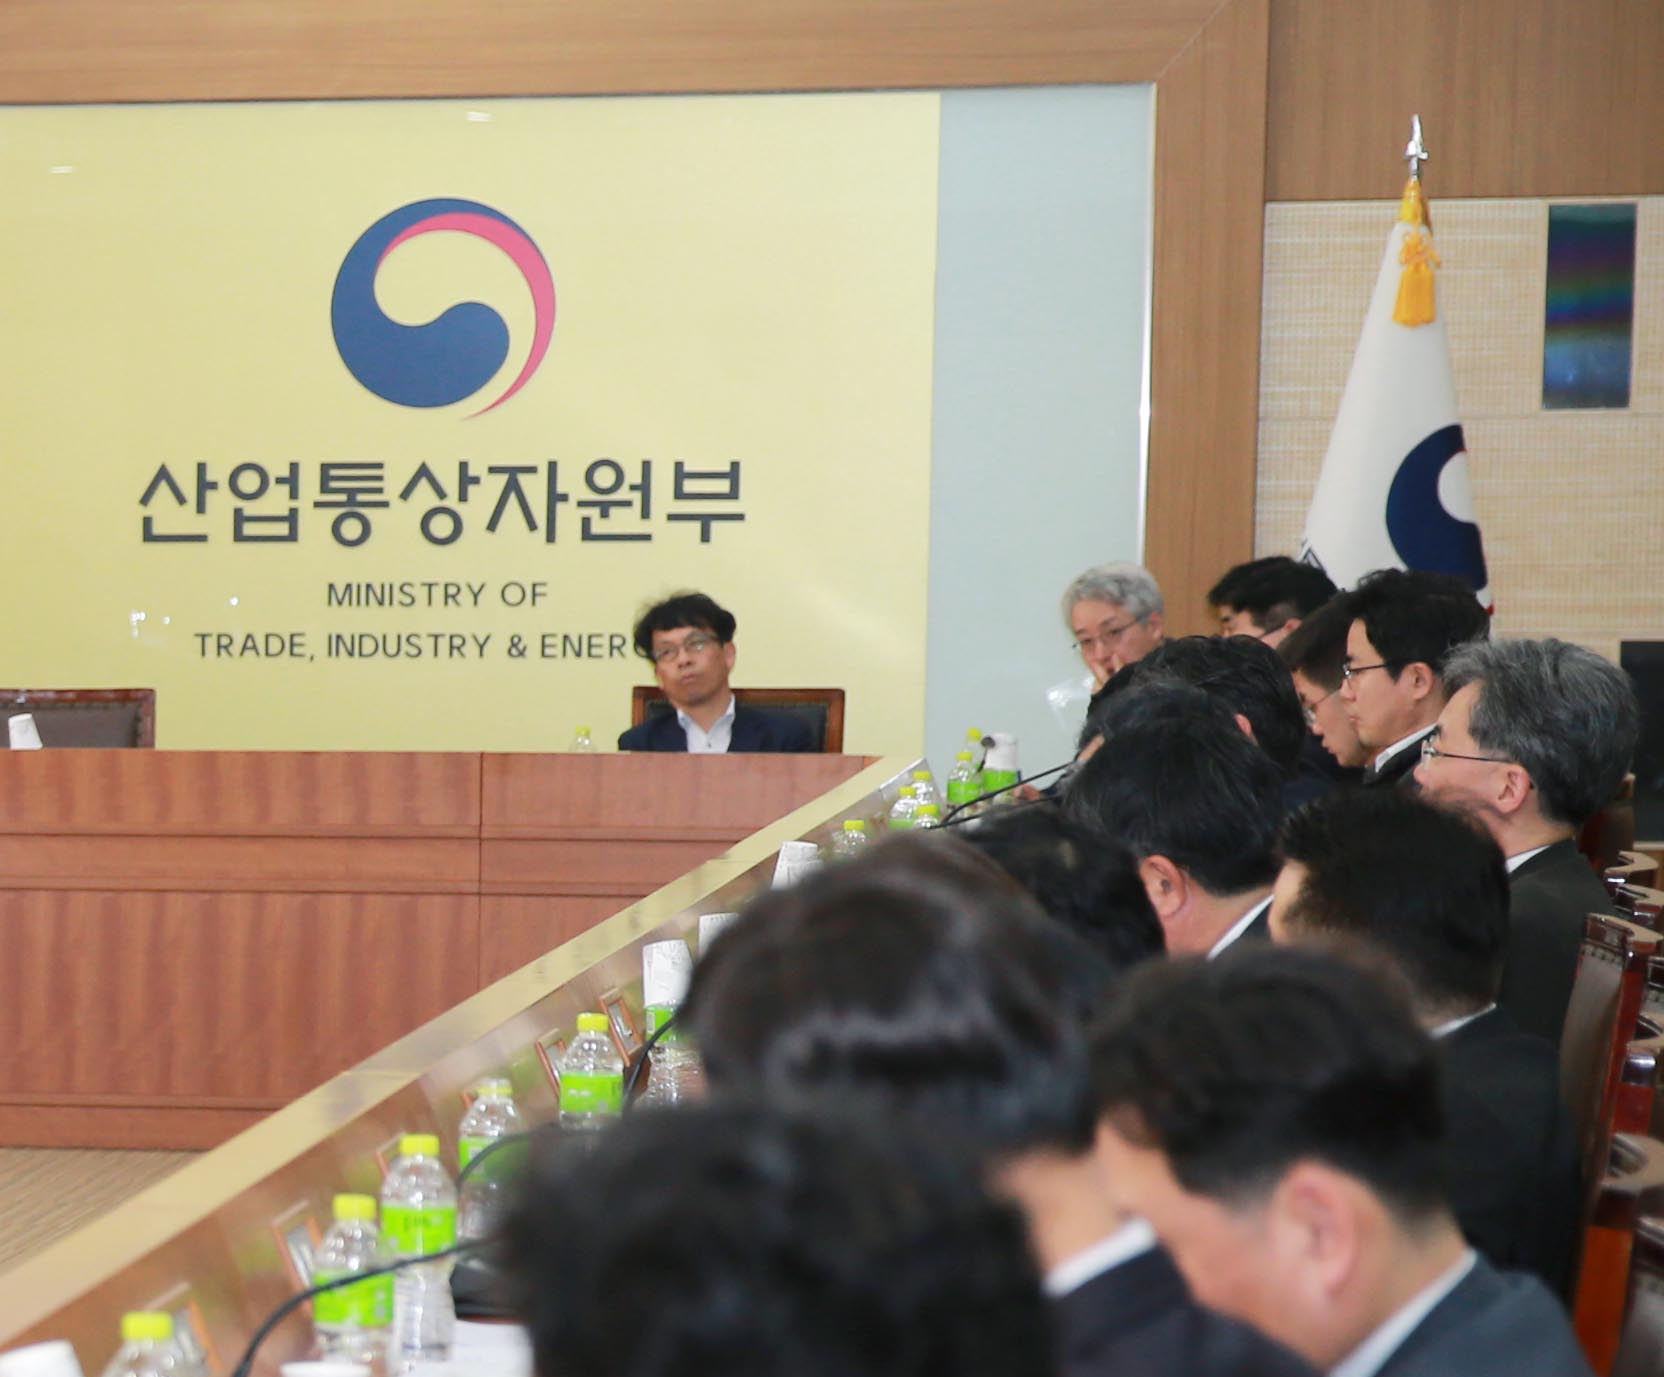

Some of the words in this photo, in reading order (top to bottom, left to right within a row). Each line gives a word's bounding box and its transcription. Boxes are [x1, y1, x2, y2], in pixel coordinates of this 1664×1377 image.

[138, 458, 746, 548] 산업통상자원부
[327, 582, 486, 608] MINISTRY
[500, 582, 547, 608] OF
[193, 632, 315, 662] TRADE,
[327, 632, 492, 659] INDUSTRY
[507, 633, 528, 659] &
